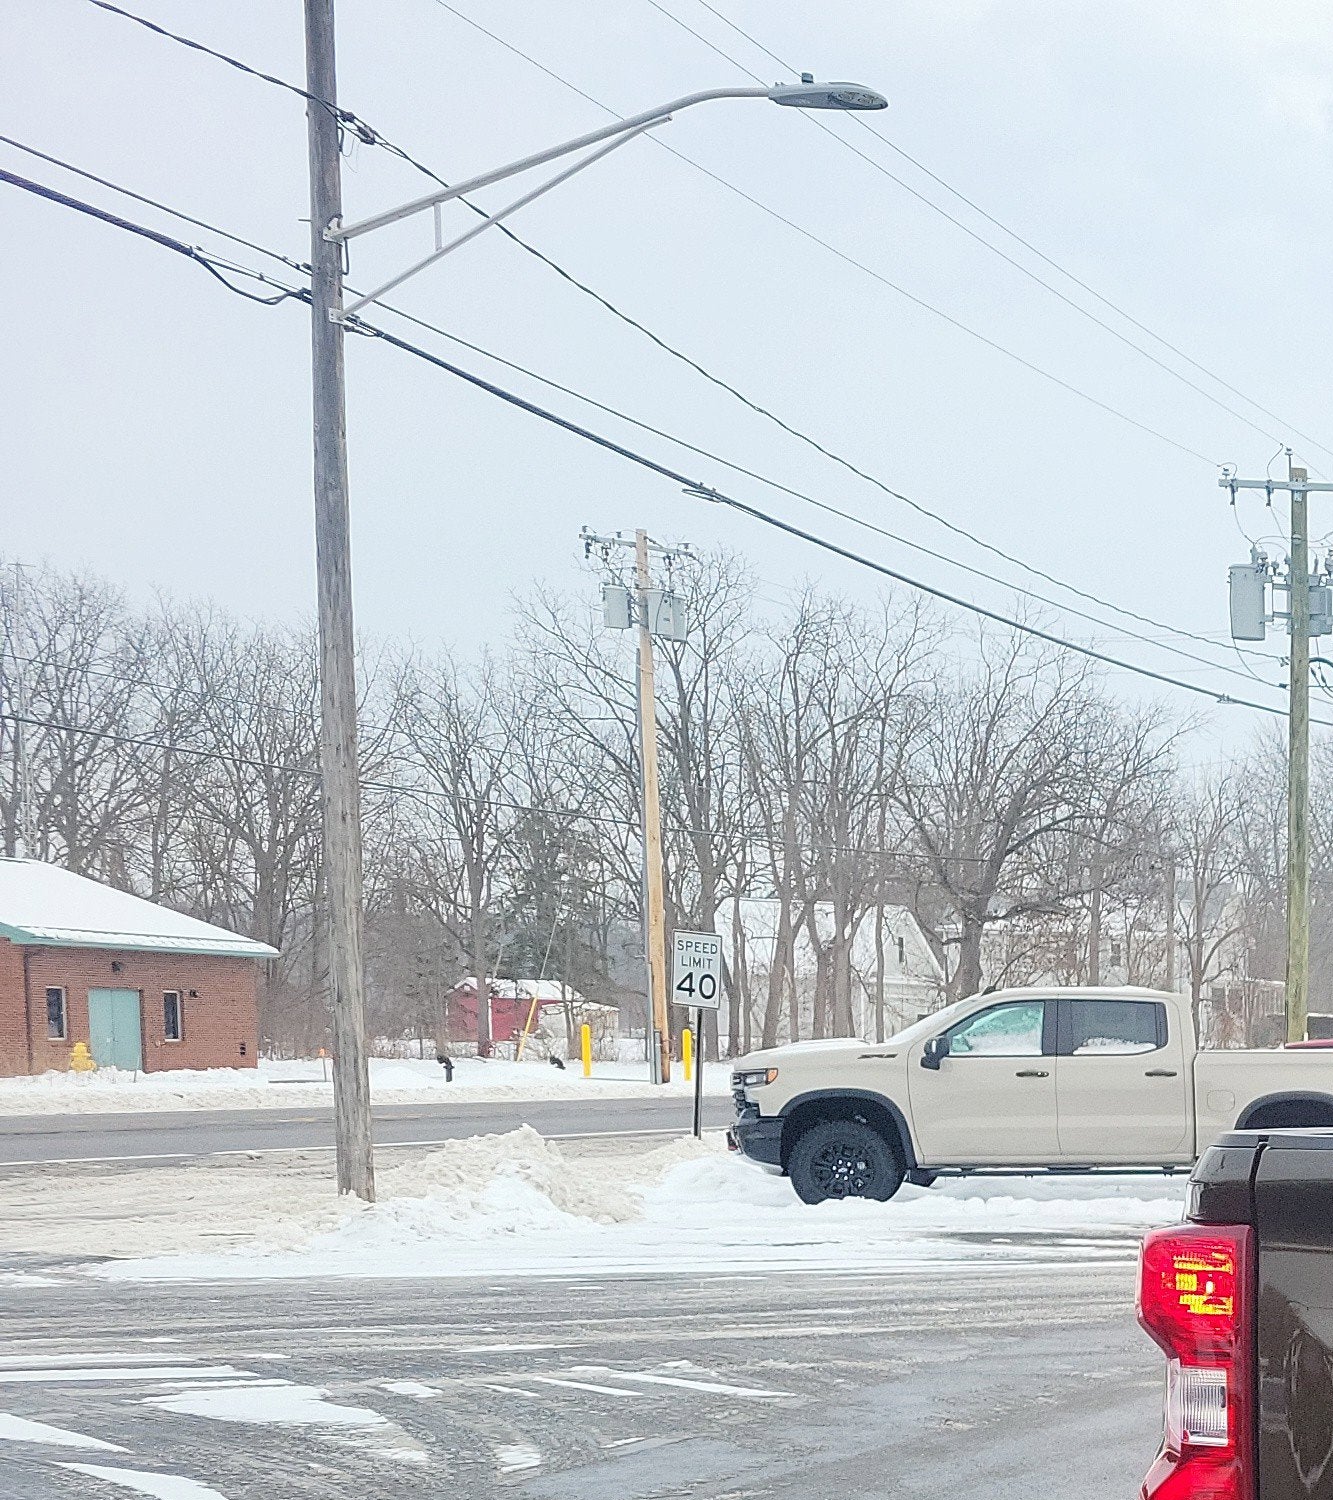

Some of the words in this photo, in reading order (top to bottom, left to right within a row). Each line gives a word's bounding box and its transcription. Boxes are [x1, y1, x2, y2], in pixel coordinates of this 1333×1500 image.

[677, 940, 718, 955] SPEED
[681, 955, 713, 969] LIMIT
[676, 971, 717, 1000] 40
